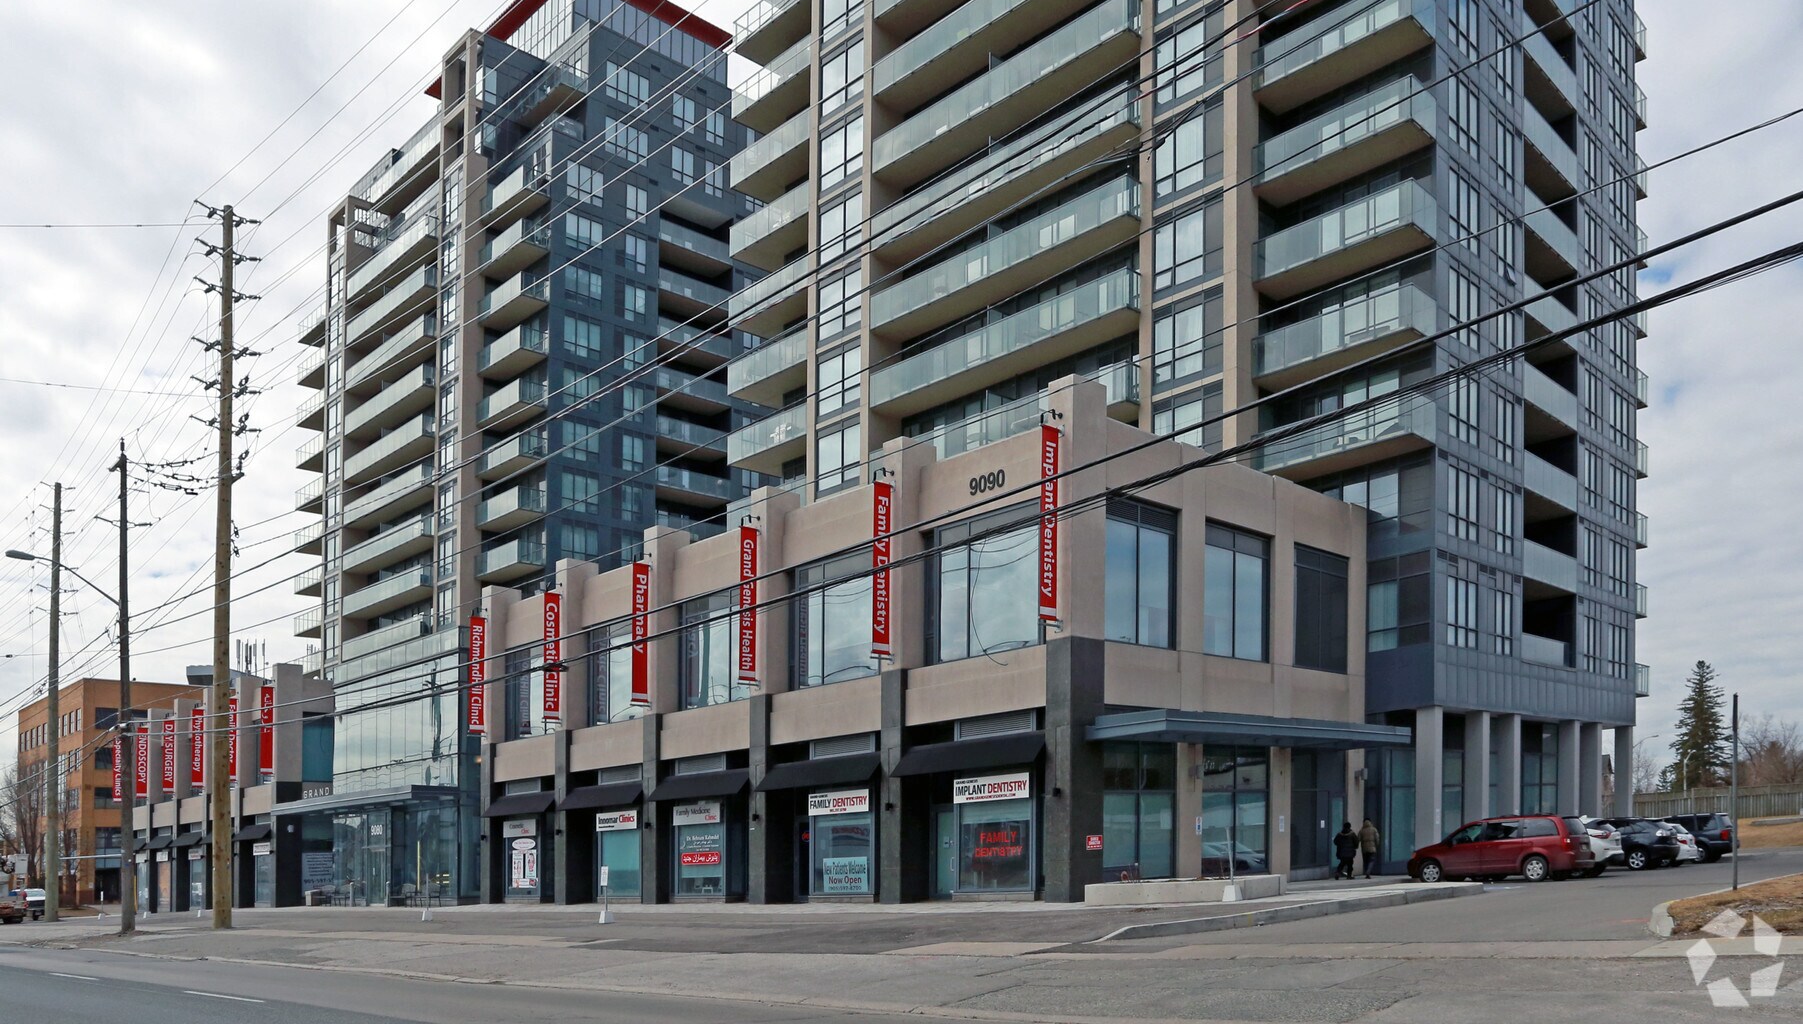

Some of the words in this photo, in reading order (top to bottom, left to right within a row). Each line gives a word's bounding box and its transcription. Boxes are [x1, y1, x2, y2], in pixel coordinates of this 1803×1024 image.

[969, 469, 1006, 496] 9090
[1043, 441, 1056, 510] Impant
[743, 539, 754, 578] Grand
[1041, 515, 1056, 597] Dentistry
[873, 556, 888, 635] Dentistry
[742, 630, 753, 670] Health
[545, 672, 558, 709] Clinic
[471, 696, 482, 725] Clinic
[192, 715, 203, 772] Phyiotherapy
[164, 743, 173, 782] SURGERY
[303, 787, 330, 799] GRAND
[955, 784, 987, 796] IMPLANT
[987, 780, 1027, 794] DENTISTRY
[809, 798, 831, 810] FAMILY
[832, 795, 867, 808] DENTISTRY
[370, 824, 383, 836] 9080
[619, 814, 635, 823] Clinics
[975, 846, 1023, 857] DENTISTRY
[980, 831, 1017, 844] FAMILY
[829, 876, 843, 884] Now
[844, 875, 862, 885] Open
